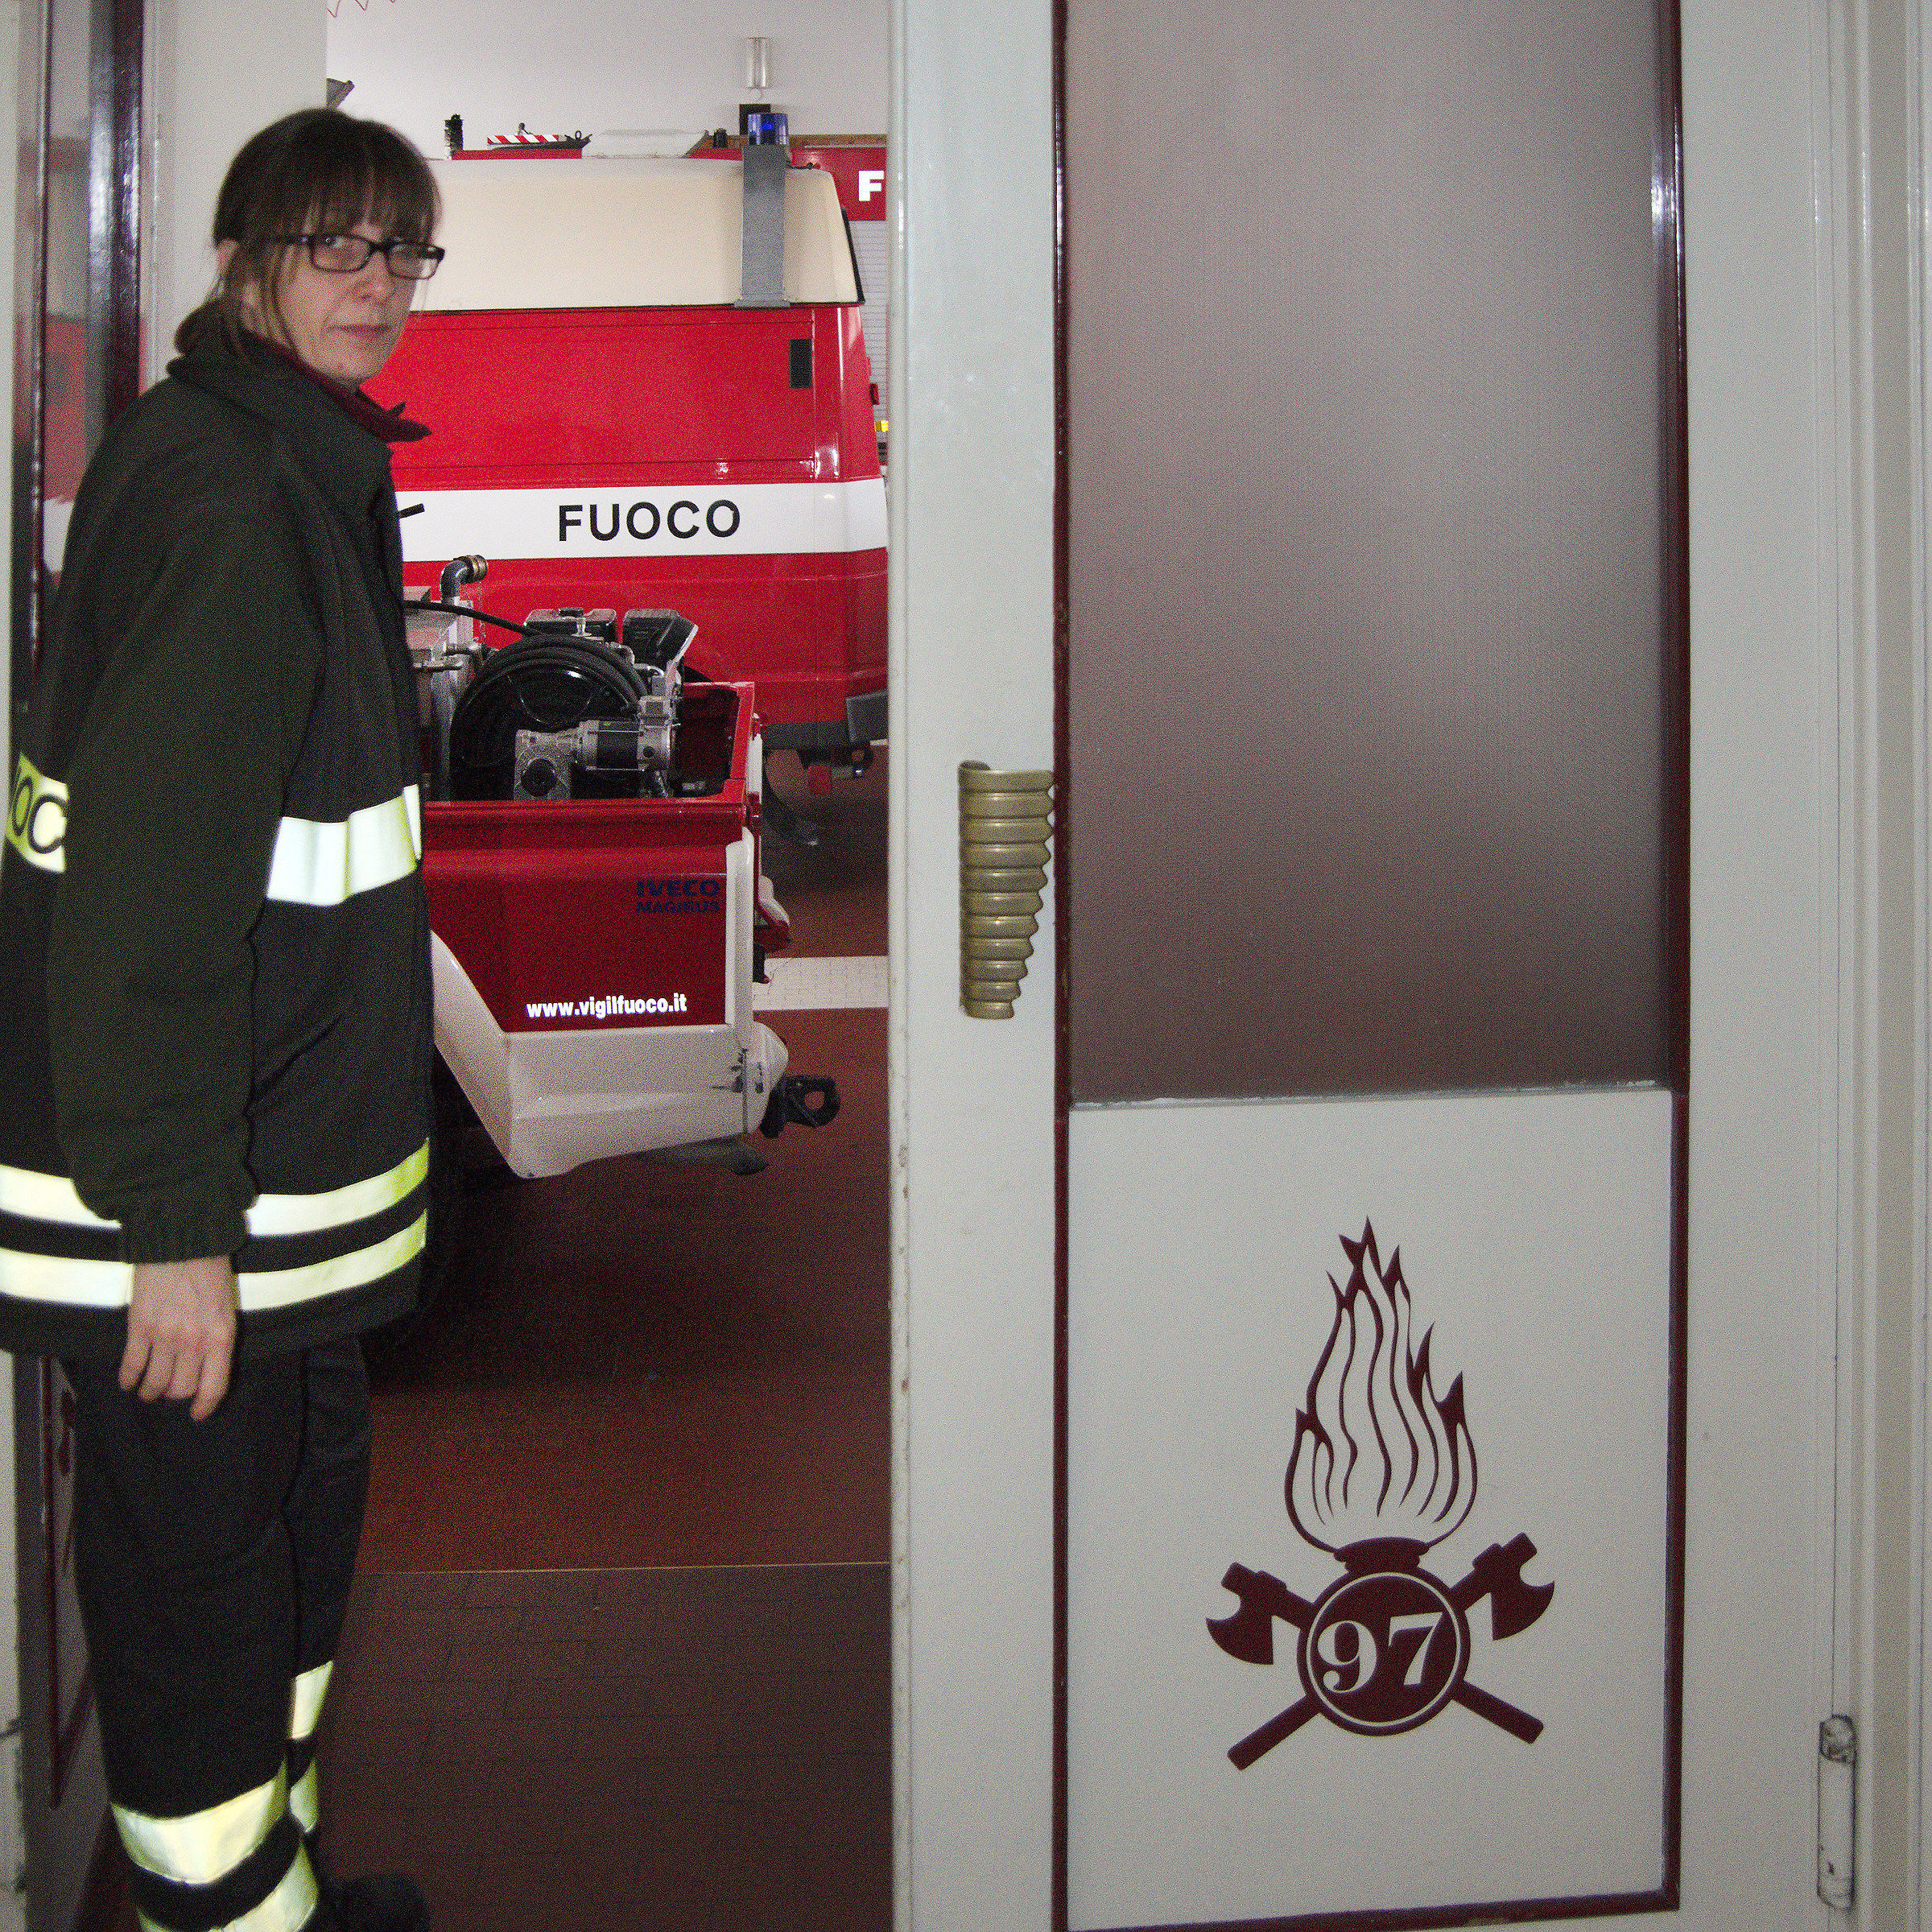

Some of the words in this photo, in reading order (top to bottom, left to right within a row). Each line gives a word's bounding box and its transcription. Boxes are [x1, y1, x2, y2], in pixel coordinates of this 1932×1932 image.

[559, 499, 741, 542] FUOCO
[637, 879, 720, 898] IVECO
[636, 901, 720, 914] MAGIRUS
[526, 992, 687, 1019] www.vigilfuoco.it
[1317, 1612, 1443, 1694] 97
